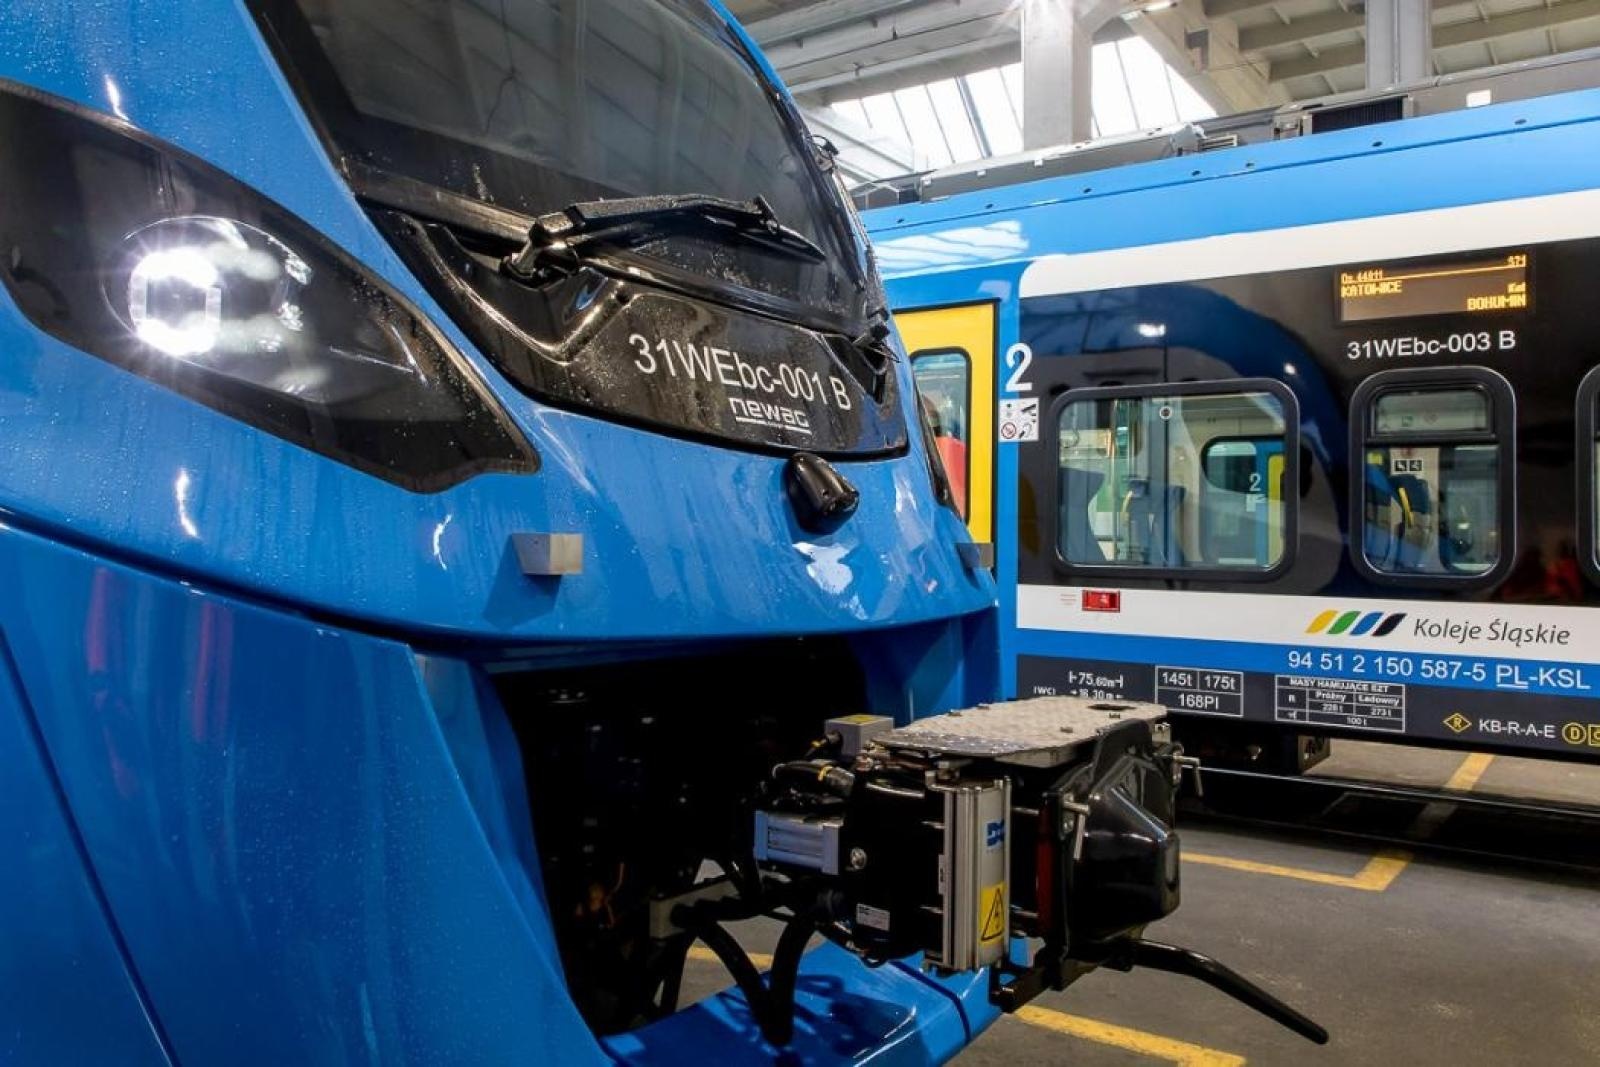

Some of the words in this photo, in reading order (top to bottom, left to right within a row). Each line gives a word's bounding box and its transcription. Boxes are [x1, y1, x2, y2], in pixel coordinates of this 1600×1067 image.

[1341, 280, 1402, 297] KATOWICE
[1347, 332, 1491, 360] 31WEbc-003
[1498, 330, 1516, 350] B
[629, 333, 828, 405] 31WEbc-001
[829, 376, 851, 410] B
[1005, 342, 1033, 393] 2
[1414, 618, 1482, 644] Koleje
[1487, 618, 1571, 647] Śląskie
[1288, 650, 1313, 669] 94
[1320, 652, 1343, 671] 51
[1352, 654, 1366, 673] 2
[1374, 656, 1414, 677] 150
[1420, 659, 1487, 682] 587-5
[1496, 664, 1591, 690] PL-KSL
[1479, 719, 1556, 739] KB-R-A-E
